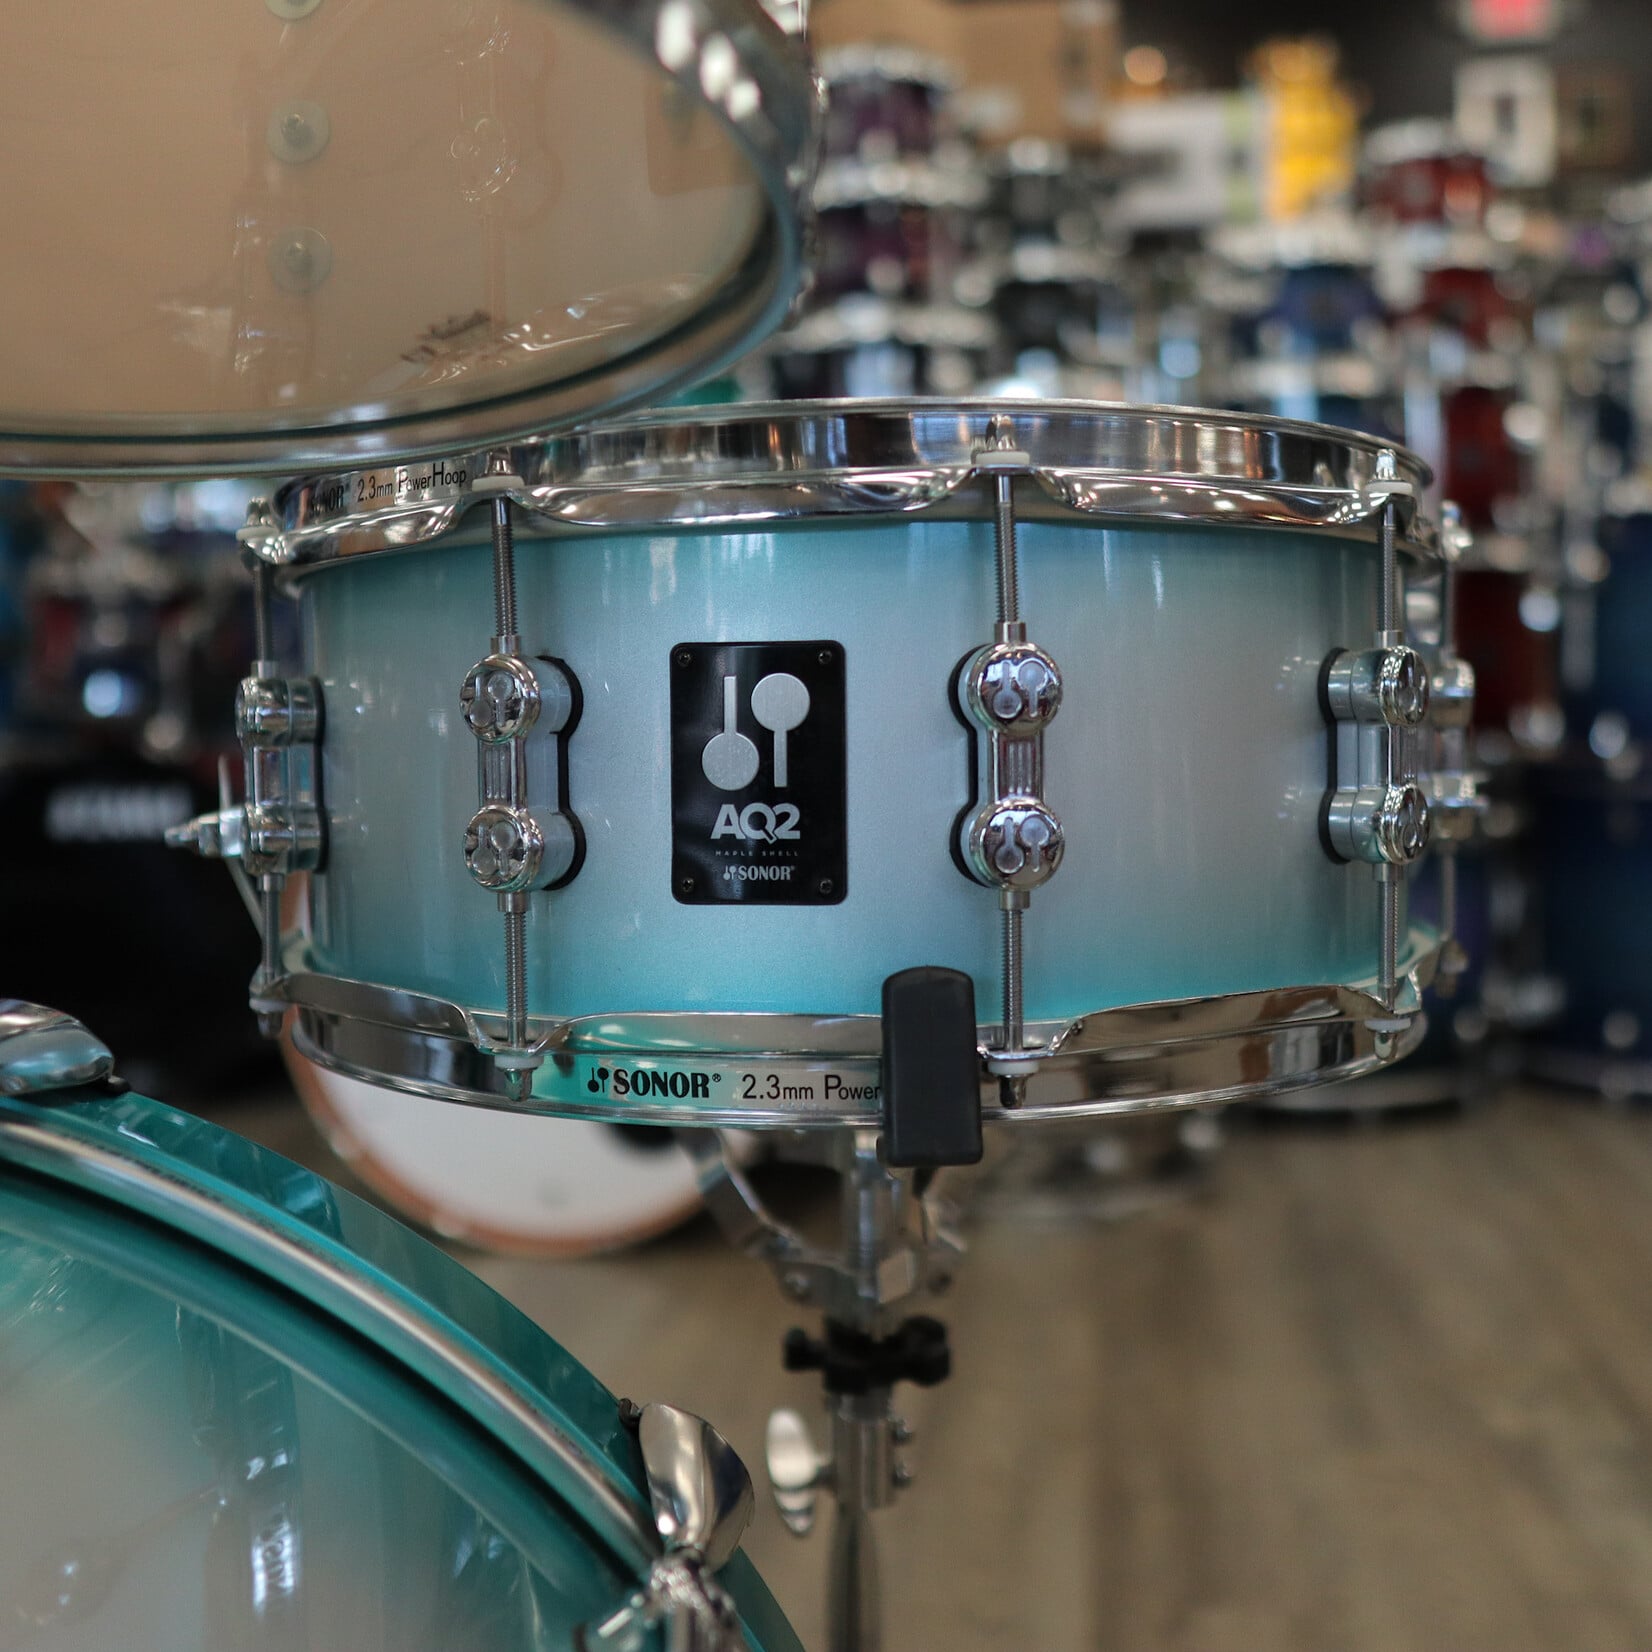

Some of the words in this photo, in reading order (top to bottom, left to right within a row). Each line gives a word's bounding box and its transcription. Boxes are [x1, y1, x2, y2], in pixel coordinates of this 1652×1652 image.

[357, 475, 393, 502] 2.3mm
[398, 461, 467, 493] PowerHoop
[710, 802, 801, 844] AQ2
[741, 1073, 814, 1100] 2.3mm
